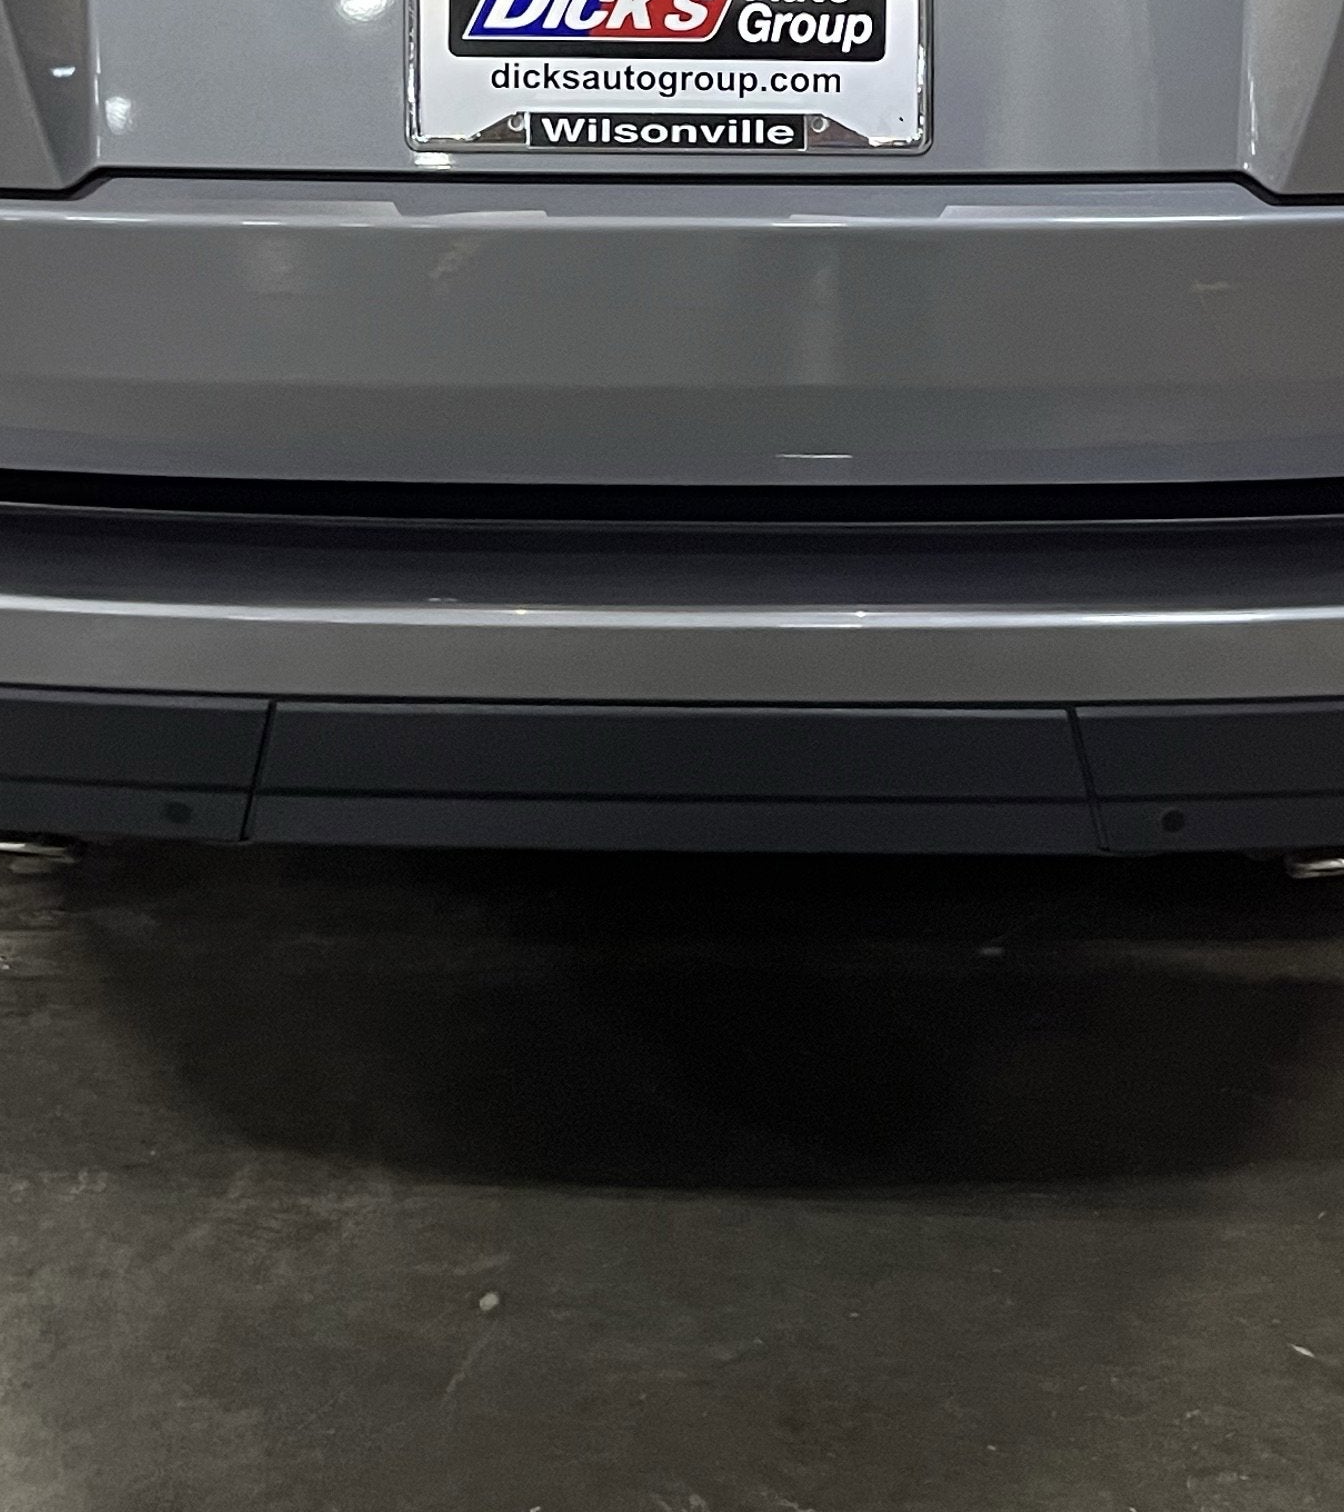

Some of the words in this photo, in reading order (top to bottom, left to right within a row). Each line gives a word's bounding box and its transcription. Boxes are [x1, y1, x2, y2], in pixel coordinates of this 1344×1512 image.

[737, 7, 874, 52] Group
[490, 63, 842, 98] dicksautogroup.com
[541, 116, 796, 145] Wilsonville
